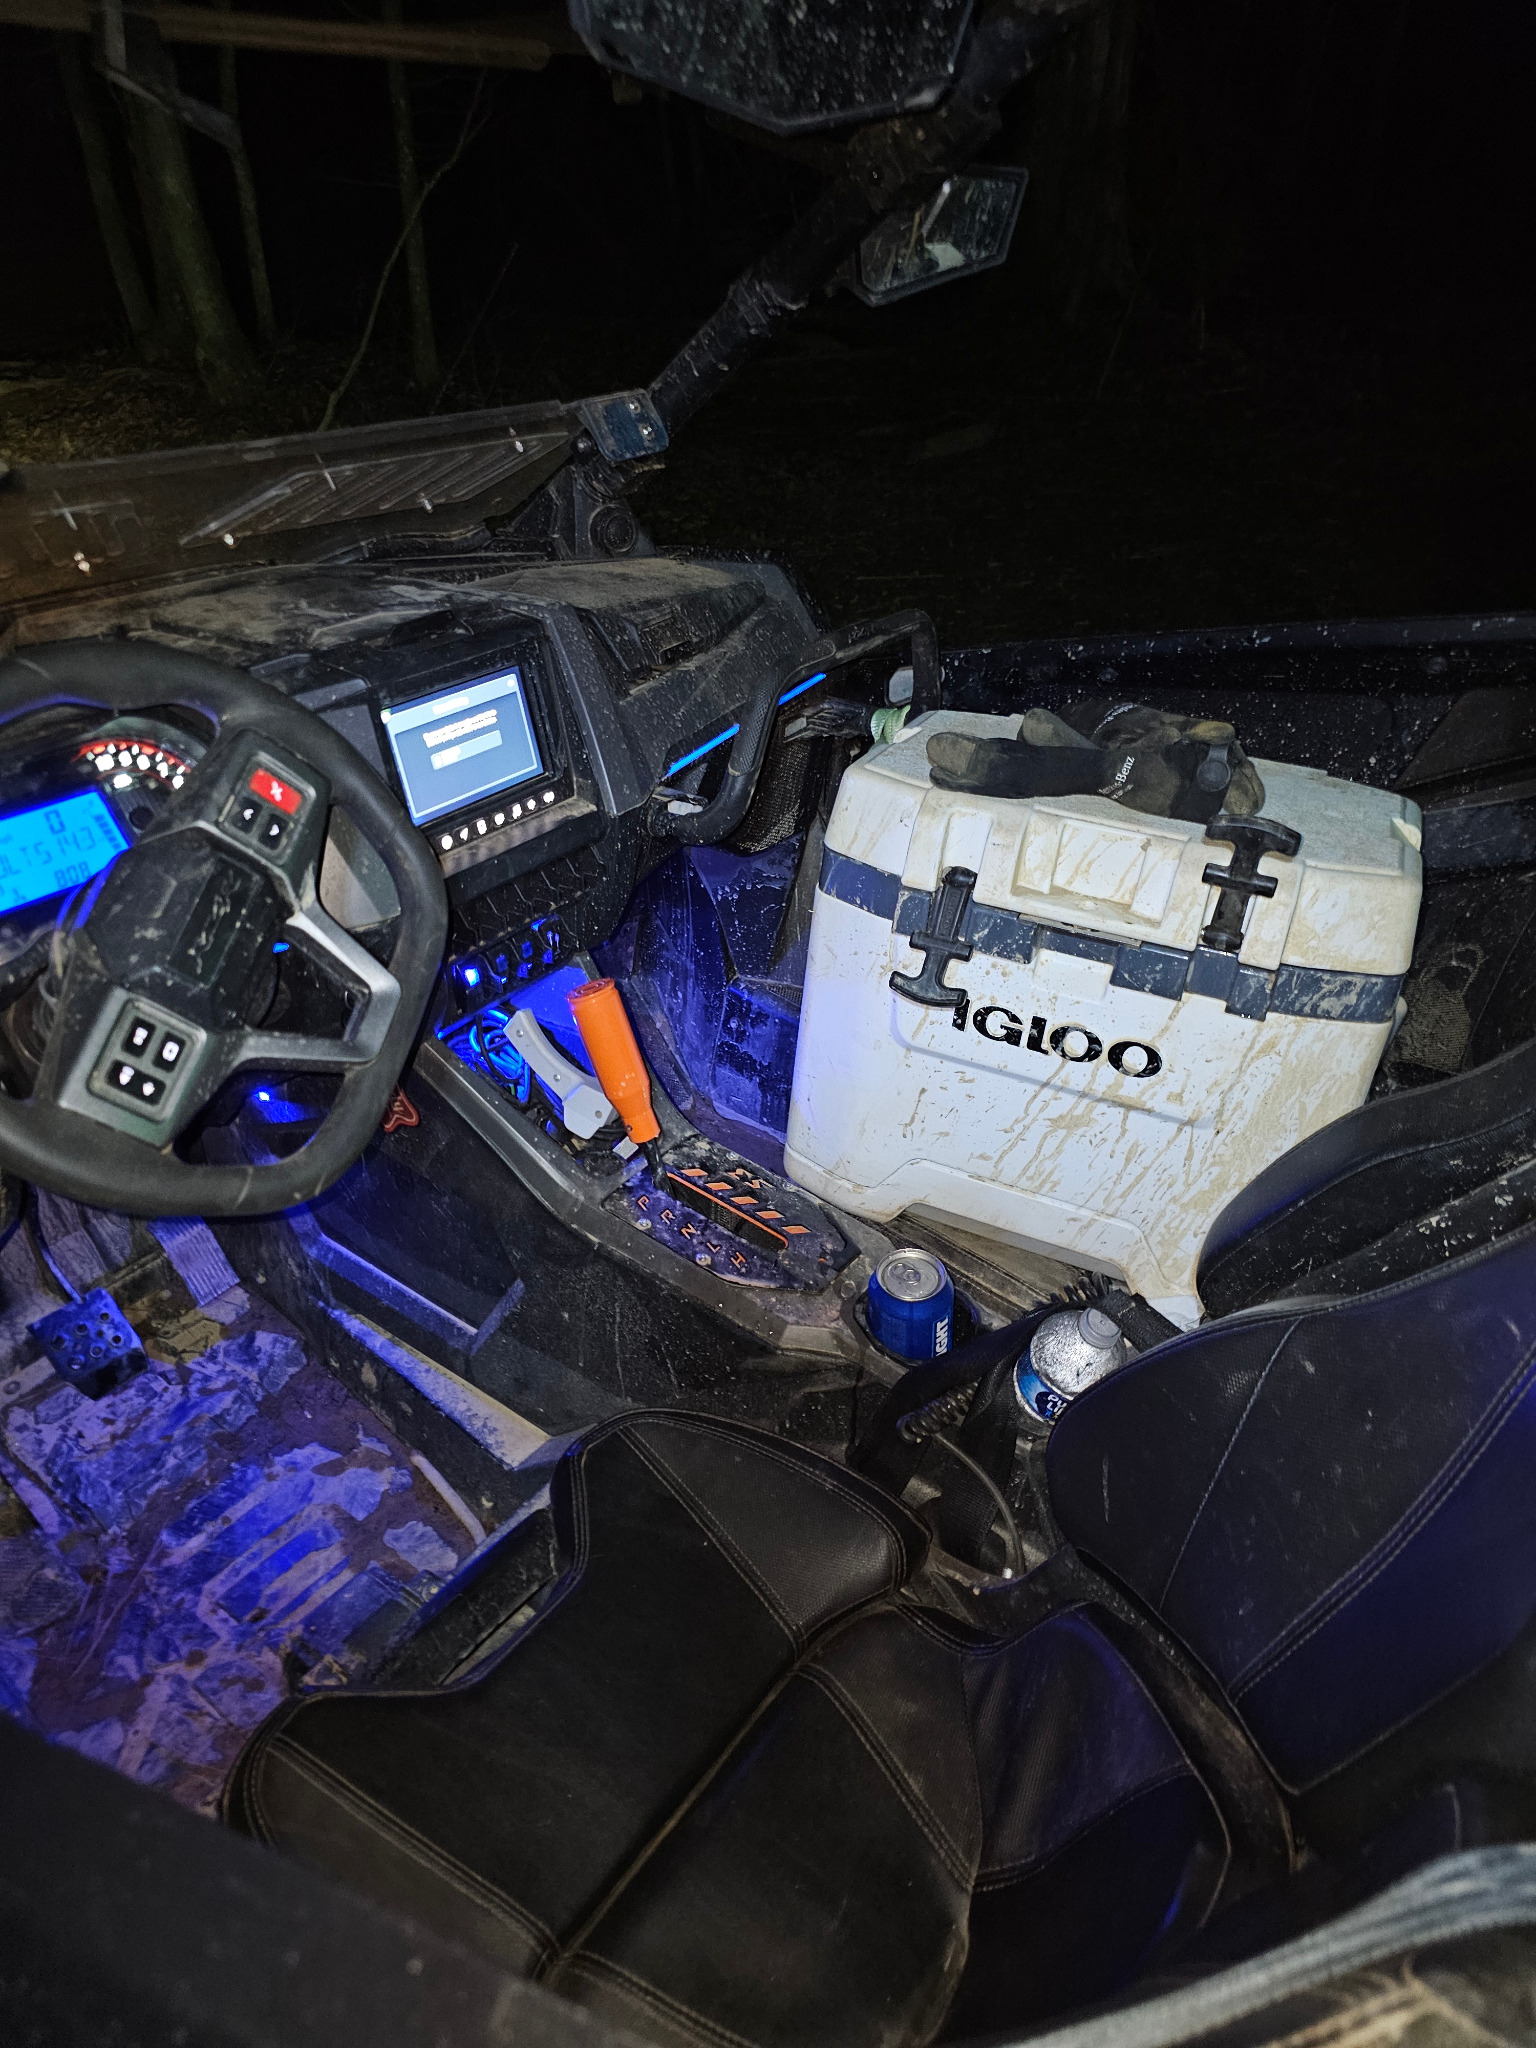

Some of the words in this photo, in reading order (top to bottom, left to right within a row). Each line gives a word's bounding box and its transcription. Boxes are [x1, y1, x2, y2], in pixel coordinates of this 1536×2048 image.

[952, 999, 1163, 1078] IGLOO
[637, 1195, 650, 1211] P
[660, 1209, 676, 1225] R
[681, 1223, 698, 1239] N
[706, 1242, 720, 1253] L
[730, 1251, 747, 1269] H
[1047, 1394, 1068, 1409] PU
